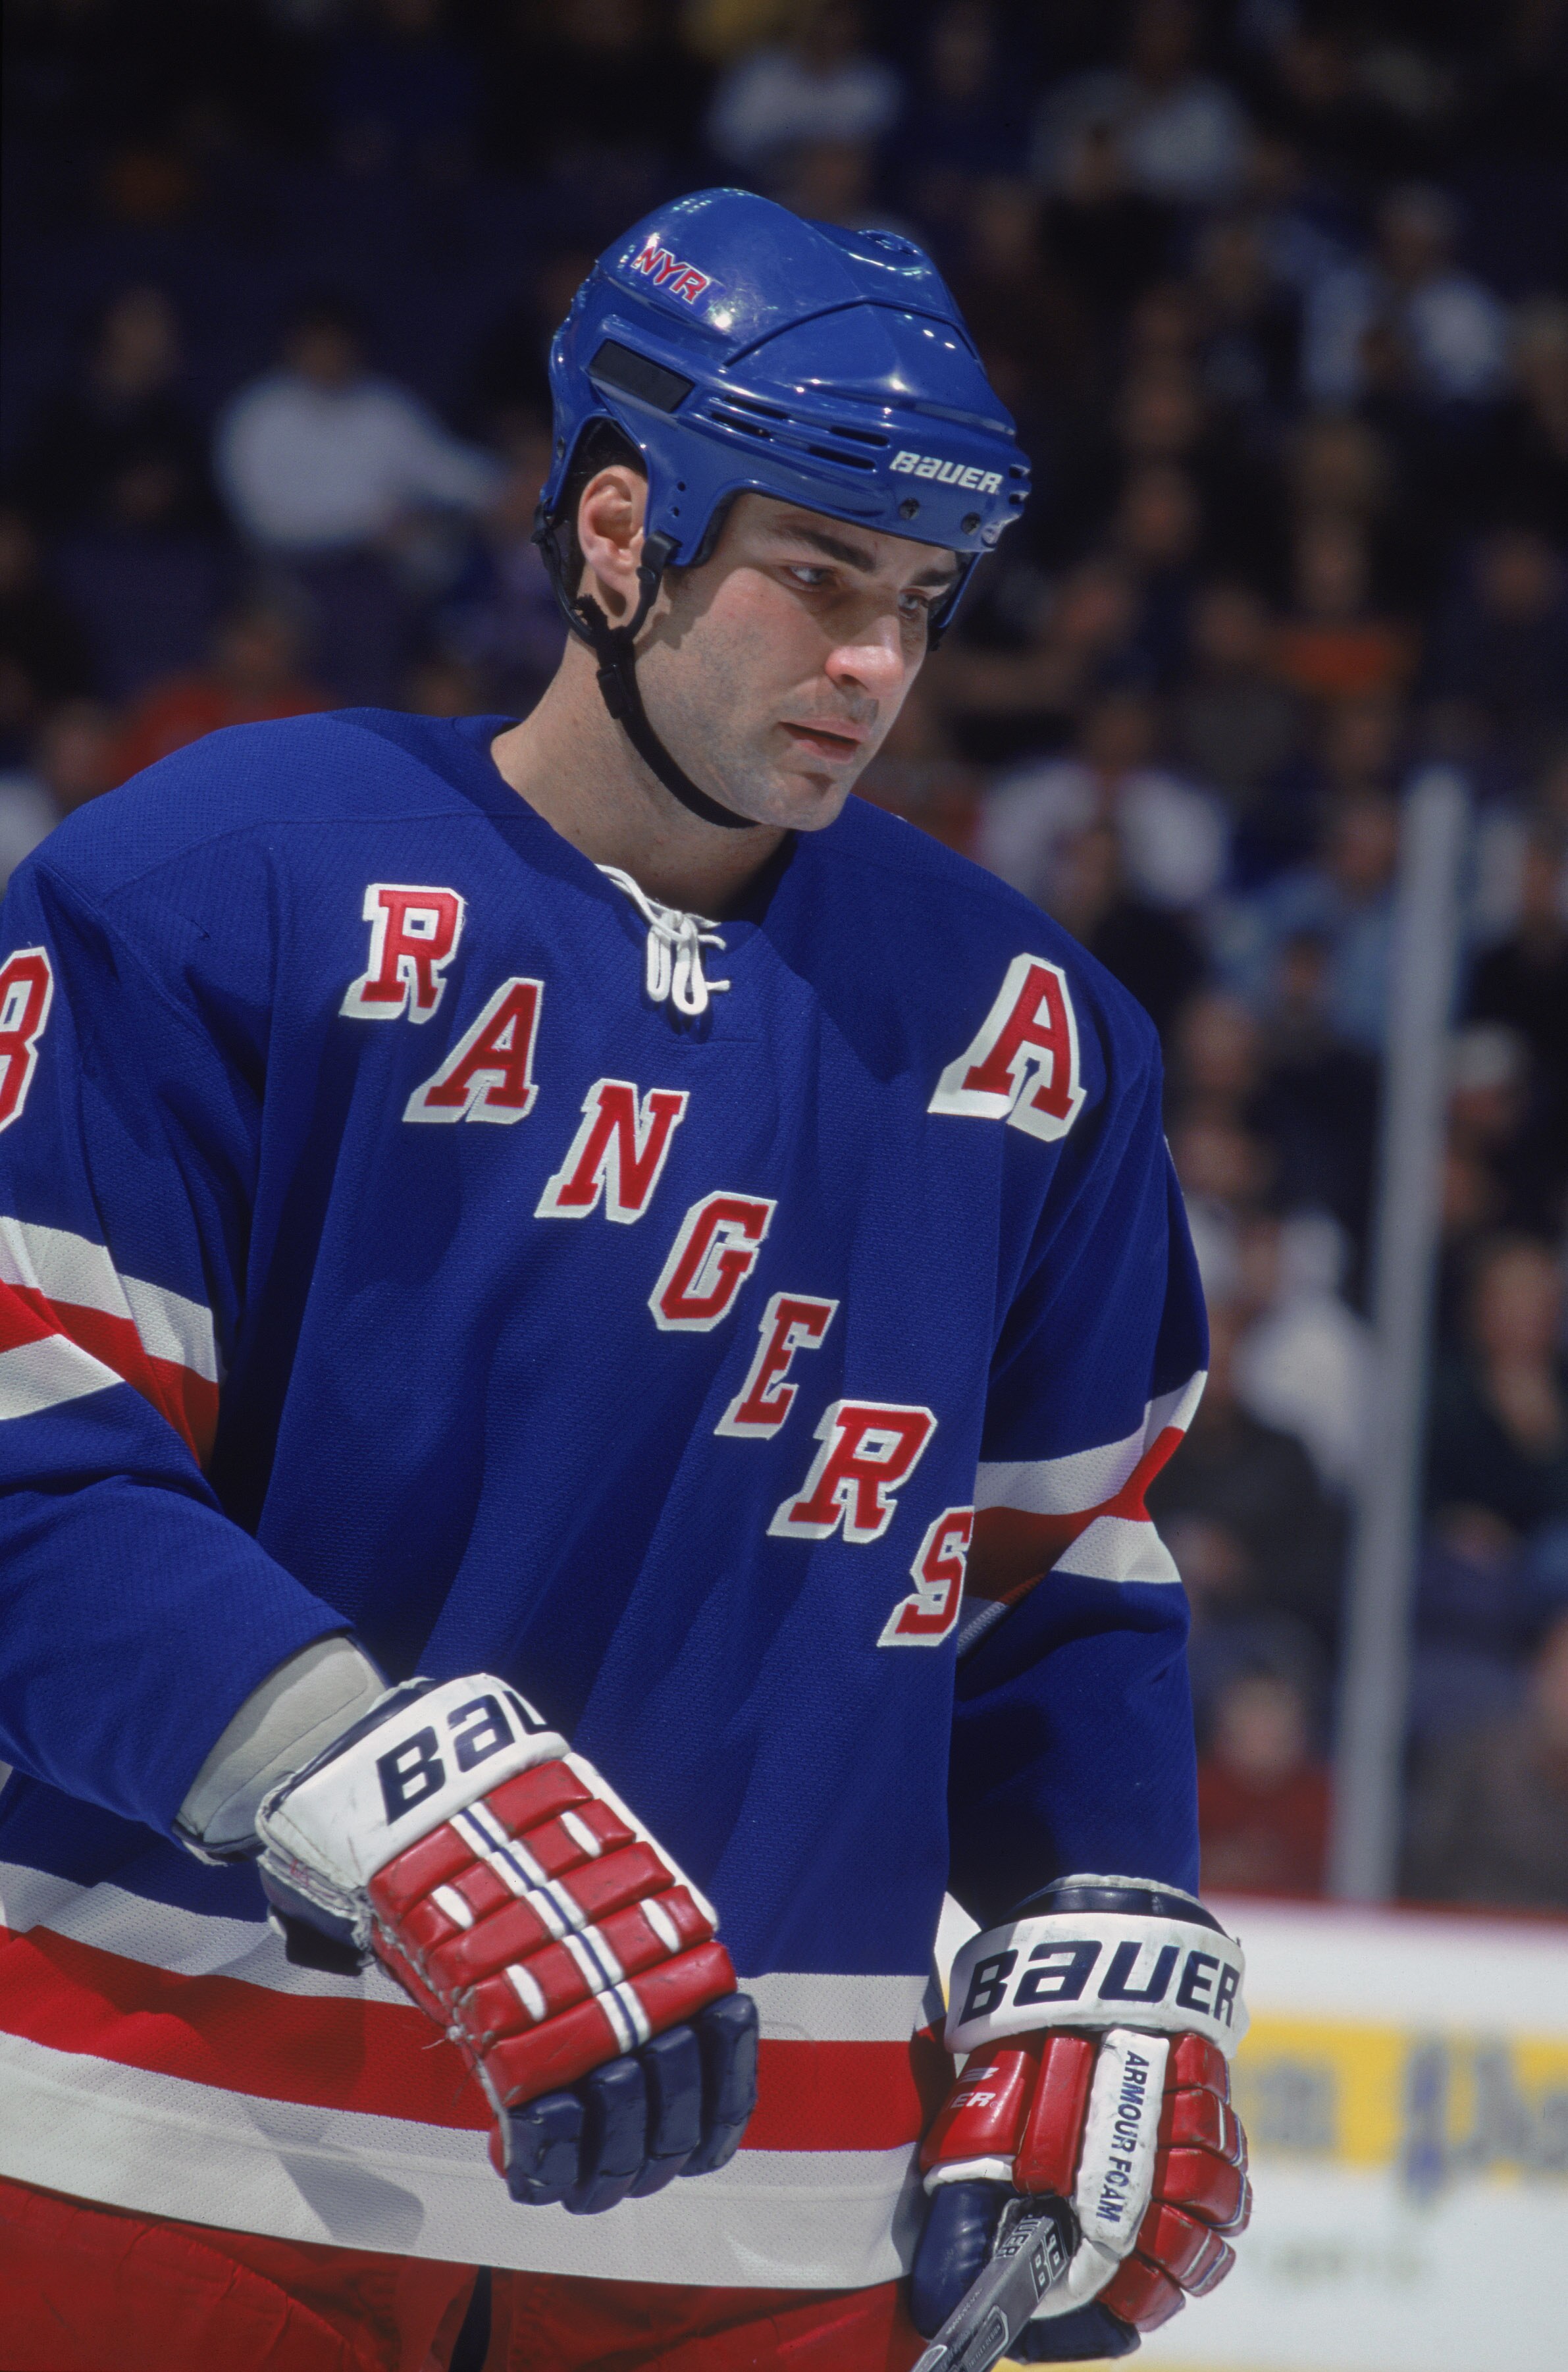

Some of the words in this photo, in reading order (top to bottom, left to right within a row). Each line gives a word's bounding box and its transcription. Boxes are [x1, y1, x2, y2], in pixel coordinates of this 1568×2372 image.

[630, 244, 711, 304] NYR
[927, 953, 1087, 1142] A
[339, 883, 974, 1647] RANGERS
[1110, 2049, 1150, 2153] ARMOUR
[1095, 2155, 1132, 2223] FOAM
